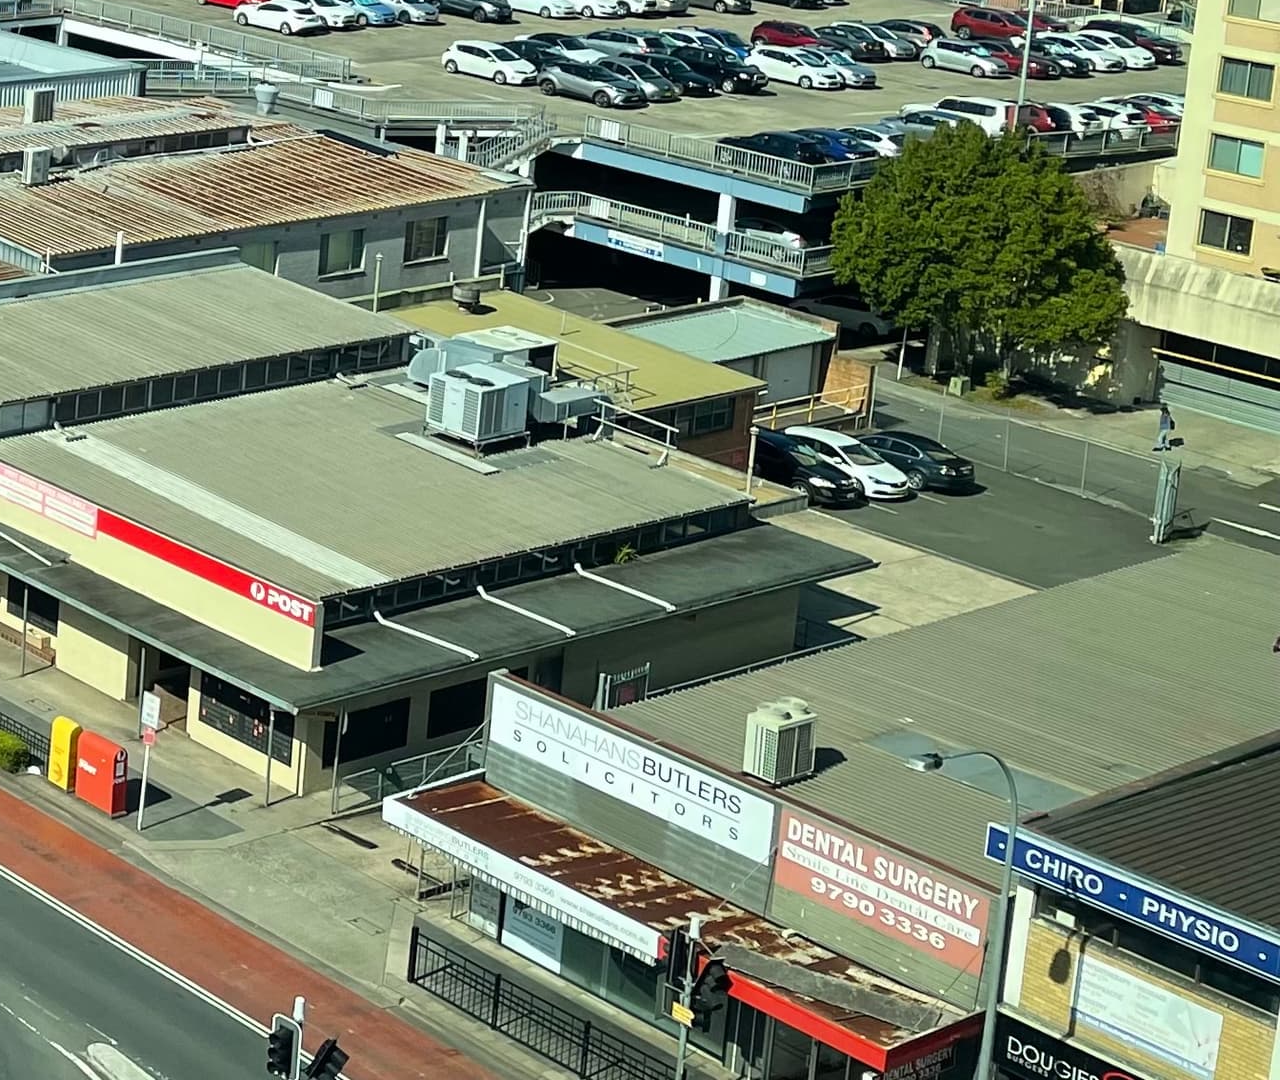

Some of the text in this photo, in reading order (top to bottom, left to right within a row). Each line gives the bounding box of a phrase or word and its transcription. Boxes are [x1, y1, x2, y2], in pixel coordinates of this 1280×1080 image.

[267, 588, 313, 622] POST
[512, 729, 739, 841] SOLICITORS
[787, 816, 980, 920] DENTAL SURGERY
[834, 864, 869, 893] Line
[876, 886, 928, 920] Dental
[1025, 848, 1239, 952] CHIRO PHYSIO
[810, 877, 946, 950] 9790 3336
[1006, 1052, 1049, 1078] BURGERS
